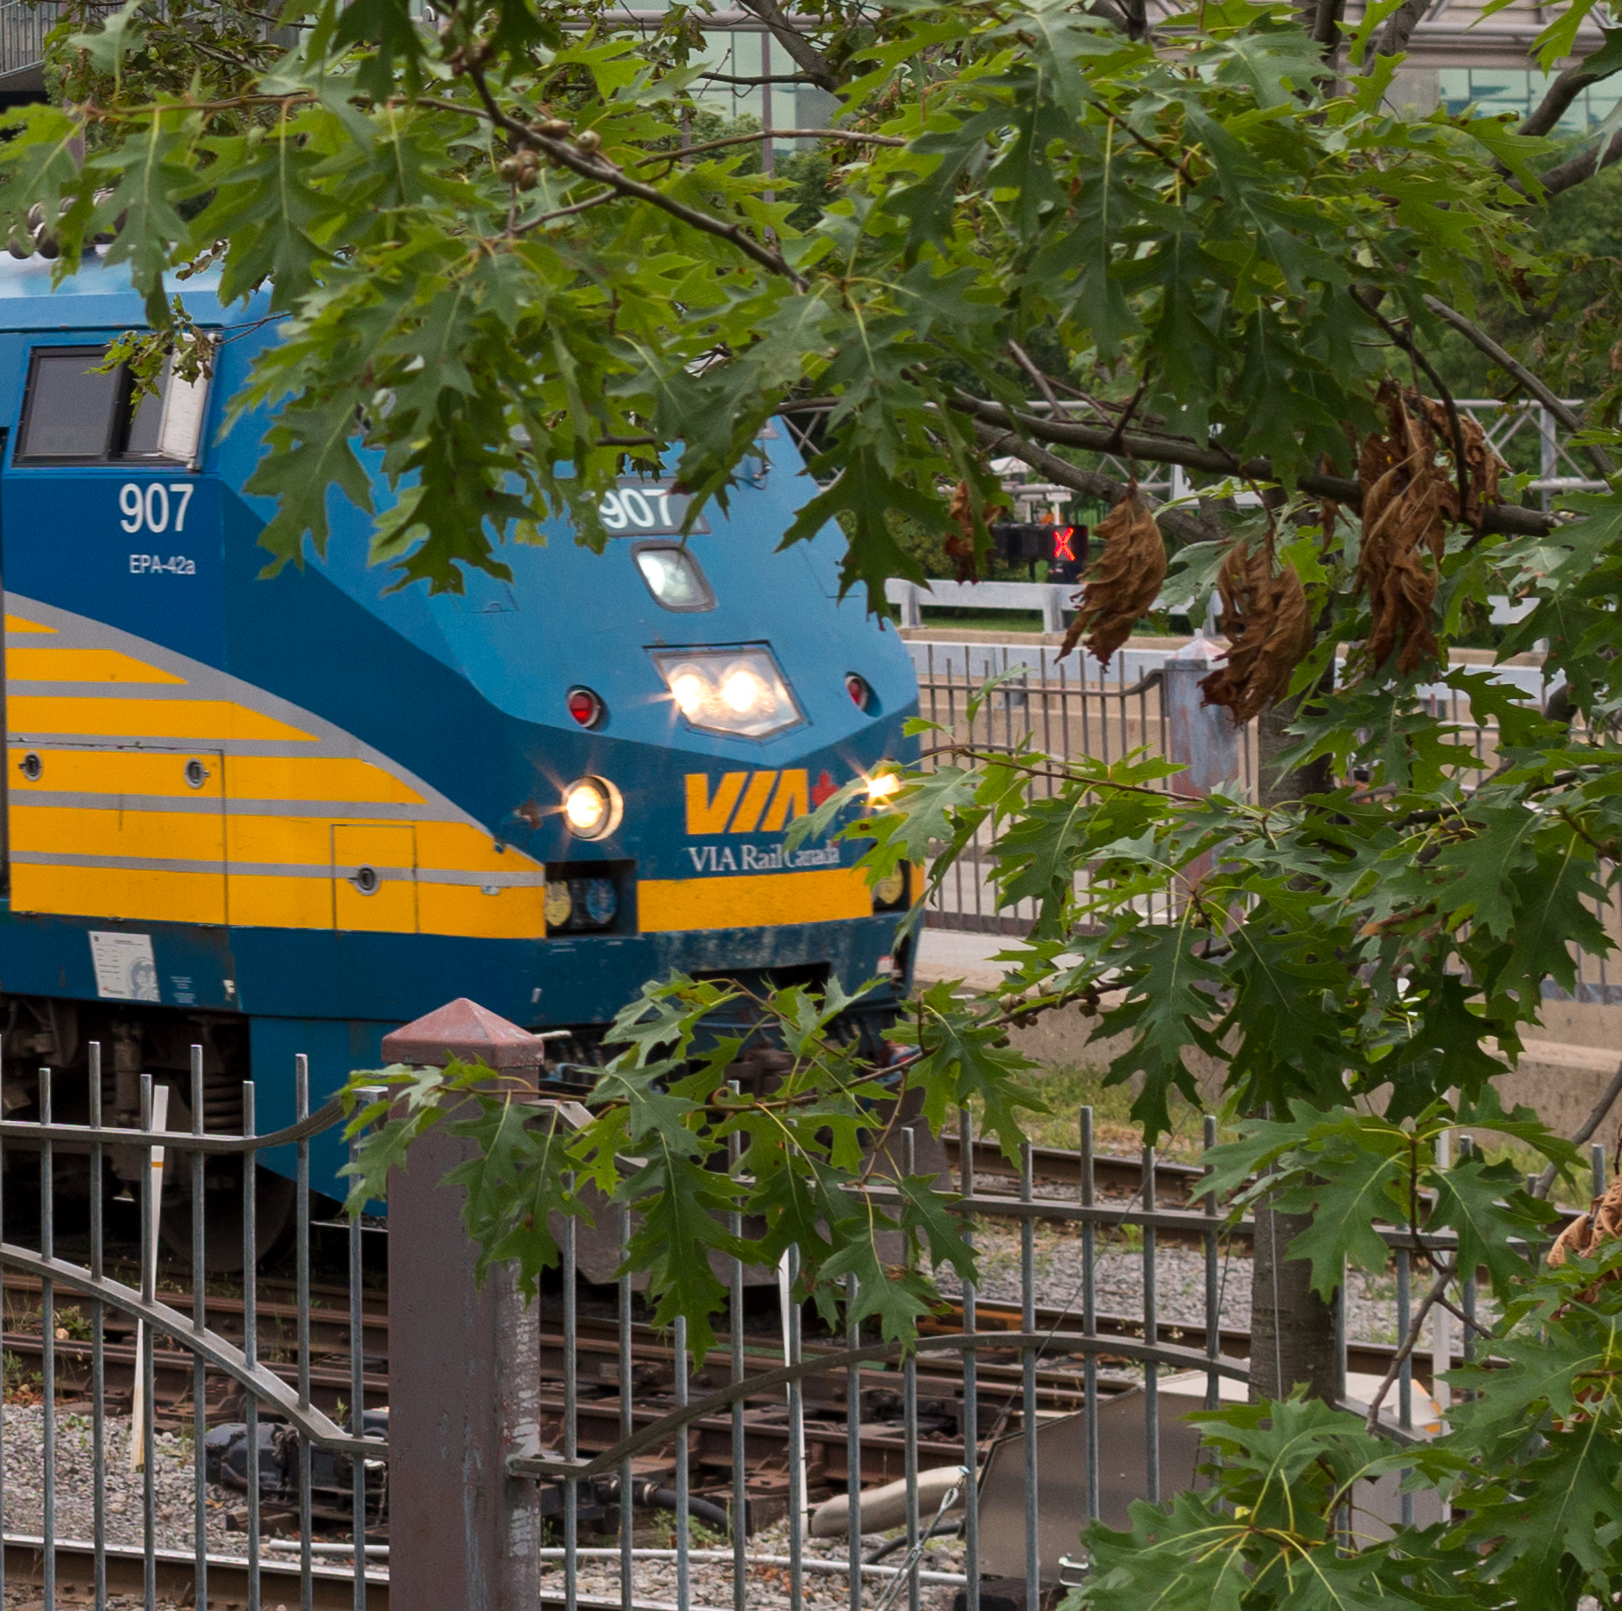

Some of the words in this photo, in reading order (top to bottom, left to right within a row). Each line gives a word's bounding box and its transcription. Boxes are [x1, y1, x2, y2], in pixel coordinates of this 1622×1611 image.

[119, 482, 194, 534] 907
[598, 488, 673, 529] 907
[129, 554, 197, 575] EPA-42a
[684, 768, 810, 835] VIA
[686, 845, 738, 873] VIA
[740, 843, 783, 870] Rail
